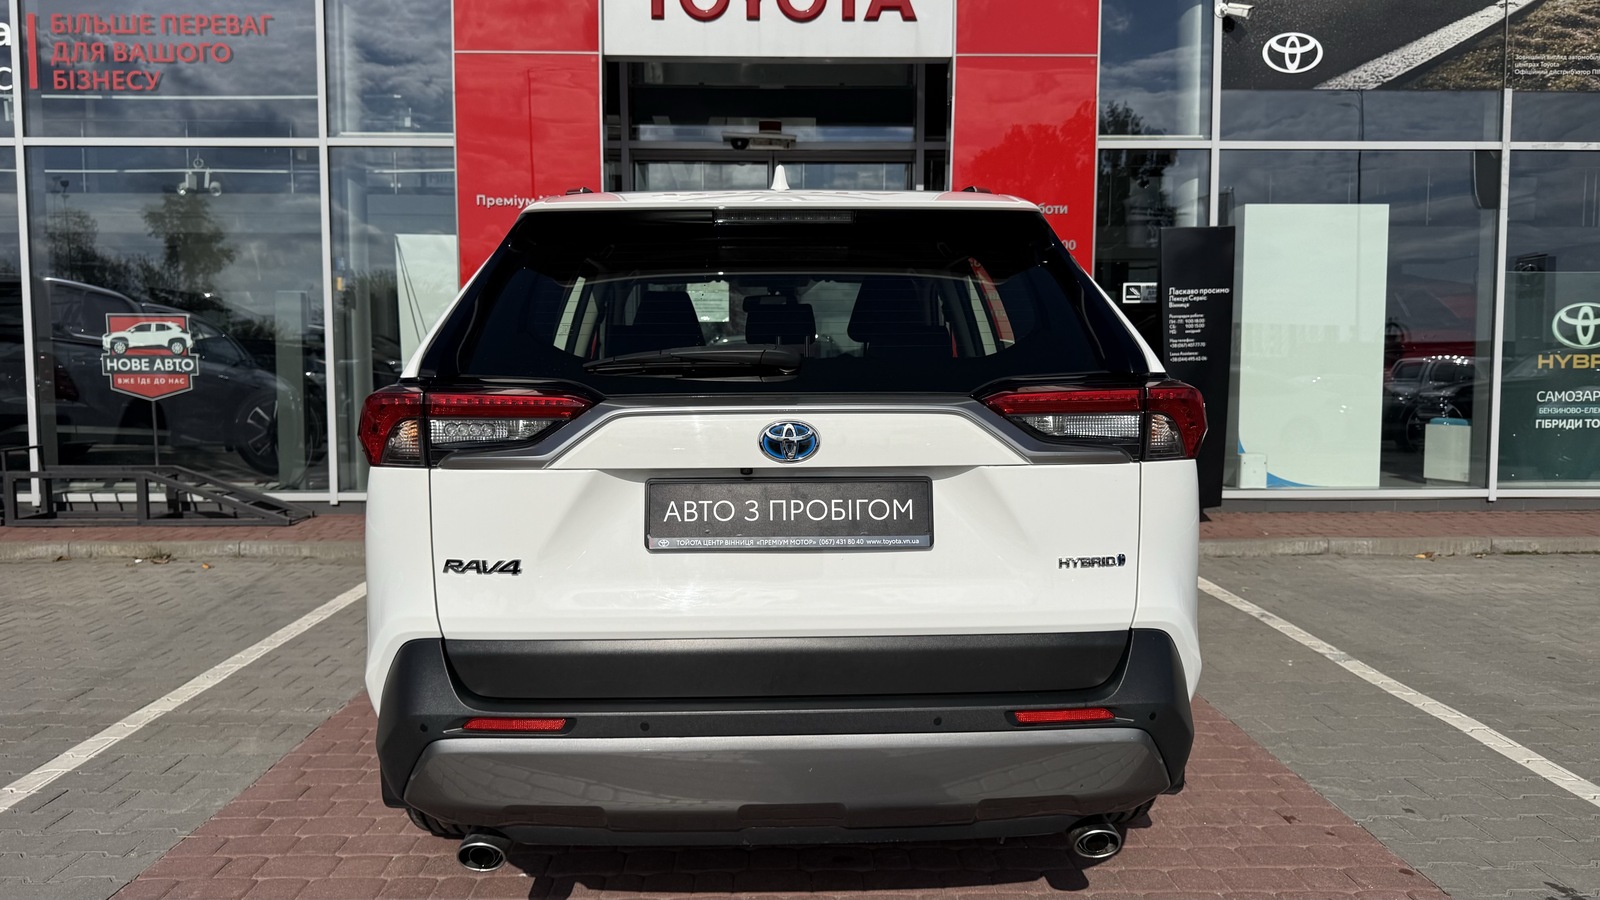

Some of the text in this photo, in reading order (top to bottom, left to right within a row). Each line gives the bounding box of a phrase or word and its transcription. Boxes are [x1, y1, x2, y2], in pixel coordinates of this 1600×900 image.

[51, 14, 273, 35] БІЛЬШЕ ПЕРЕВАГ
[51, 42, 232, 66] ДЛЯ ВАШОГО
[1540, 61, 1560, 69] Toyota
[53, 70, 161, 90] БІЗНЕСУ
[476, 194, 535, 208] Преміум
[1168, 287, 1199, 295] Ласкаво
[106, 358, 194, 371] НОВЕ АВТО
[118, 377, 135, 385] ВЖЕ
[153, 377, 166, 385] ДО
[168, 377, 185, 385] НАС
[1535, 419, 1582, 430] ГІБРИДИ
[663, 498, 913, 522] АВТО З ПРОБІГОМ
[676, 538, 702, 546] ТОЙОТА
[818, 538, 835, 546] (067)
[866, 537, 920, 546] www.toyota.vn.ua
[443, 559, 523, 576] RAV4
[1058, 556, 1117, 569] HYBRID
